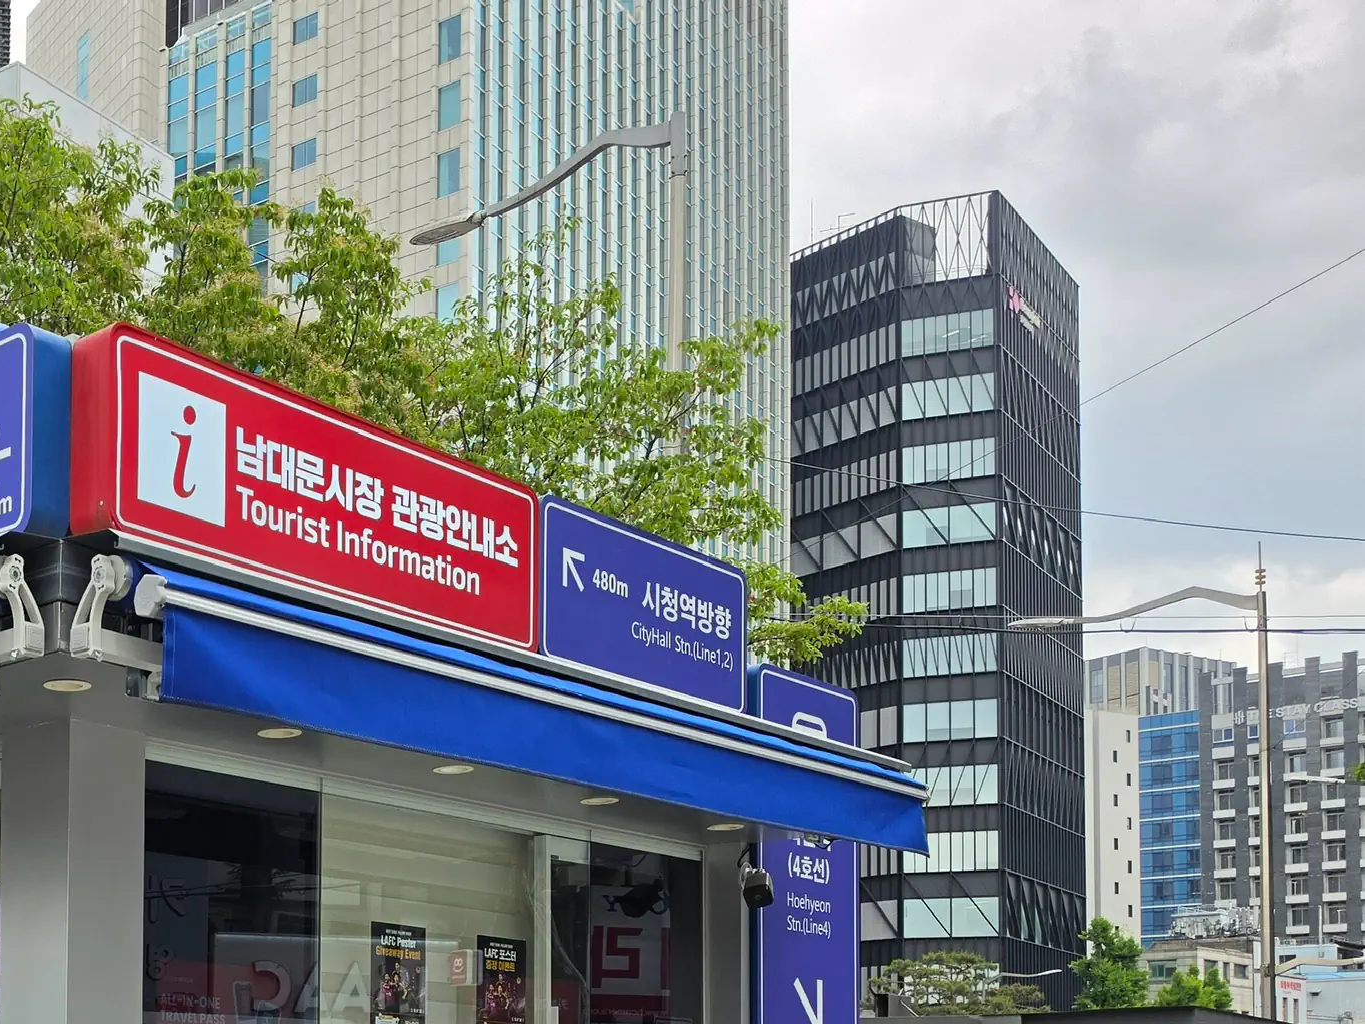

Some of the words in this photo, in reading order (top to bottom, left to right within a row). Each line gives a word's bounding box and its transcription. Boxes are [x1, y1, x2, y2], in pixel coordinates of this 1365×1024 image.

[235, 425, 384, 522] 남대문시장
[392, 491, 519, 570] 관광안내소
[235, 482, 330, 550] Tourist
[336, 518, 481, 598] Information
[592, 566, 629, 599] 480m
[641, 580, 733, 642] 시청역방향
[630, 620, 672, 652] CityHall
[674, 633, 735, 674] Stn.(Line1,2)
[787, 854, 830, 886] (4호선)
[787, 891, 831, 916] Hoehyeon
[787, 914, 831, 939] Stn.(Line4)
[380, 935, 397, 947] LAFC
[396, 936, 417, 949] Poster
[484, 947, 499, 959] LAFC
[498, 949, 517, 962] 포스터
[404, 949, 421, 961] Event
[498, 961, 515, 973] 이벤트
[160, 992, 221, 1010] ALL-IN-ONE
[160, 1011, 199, 1024] TRAVEL
